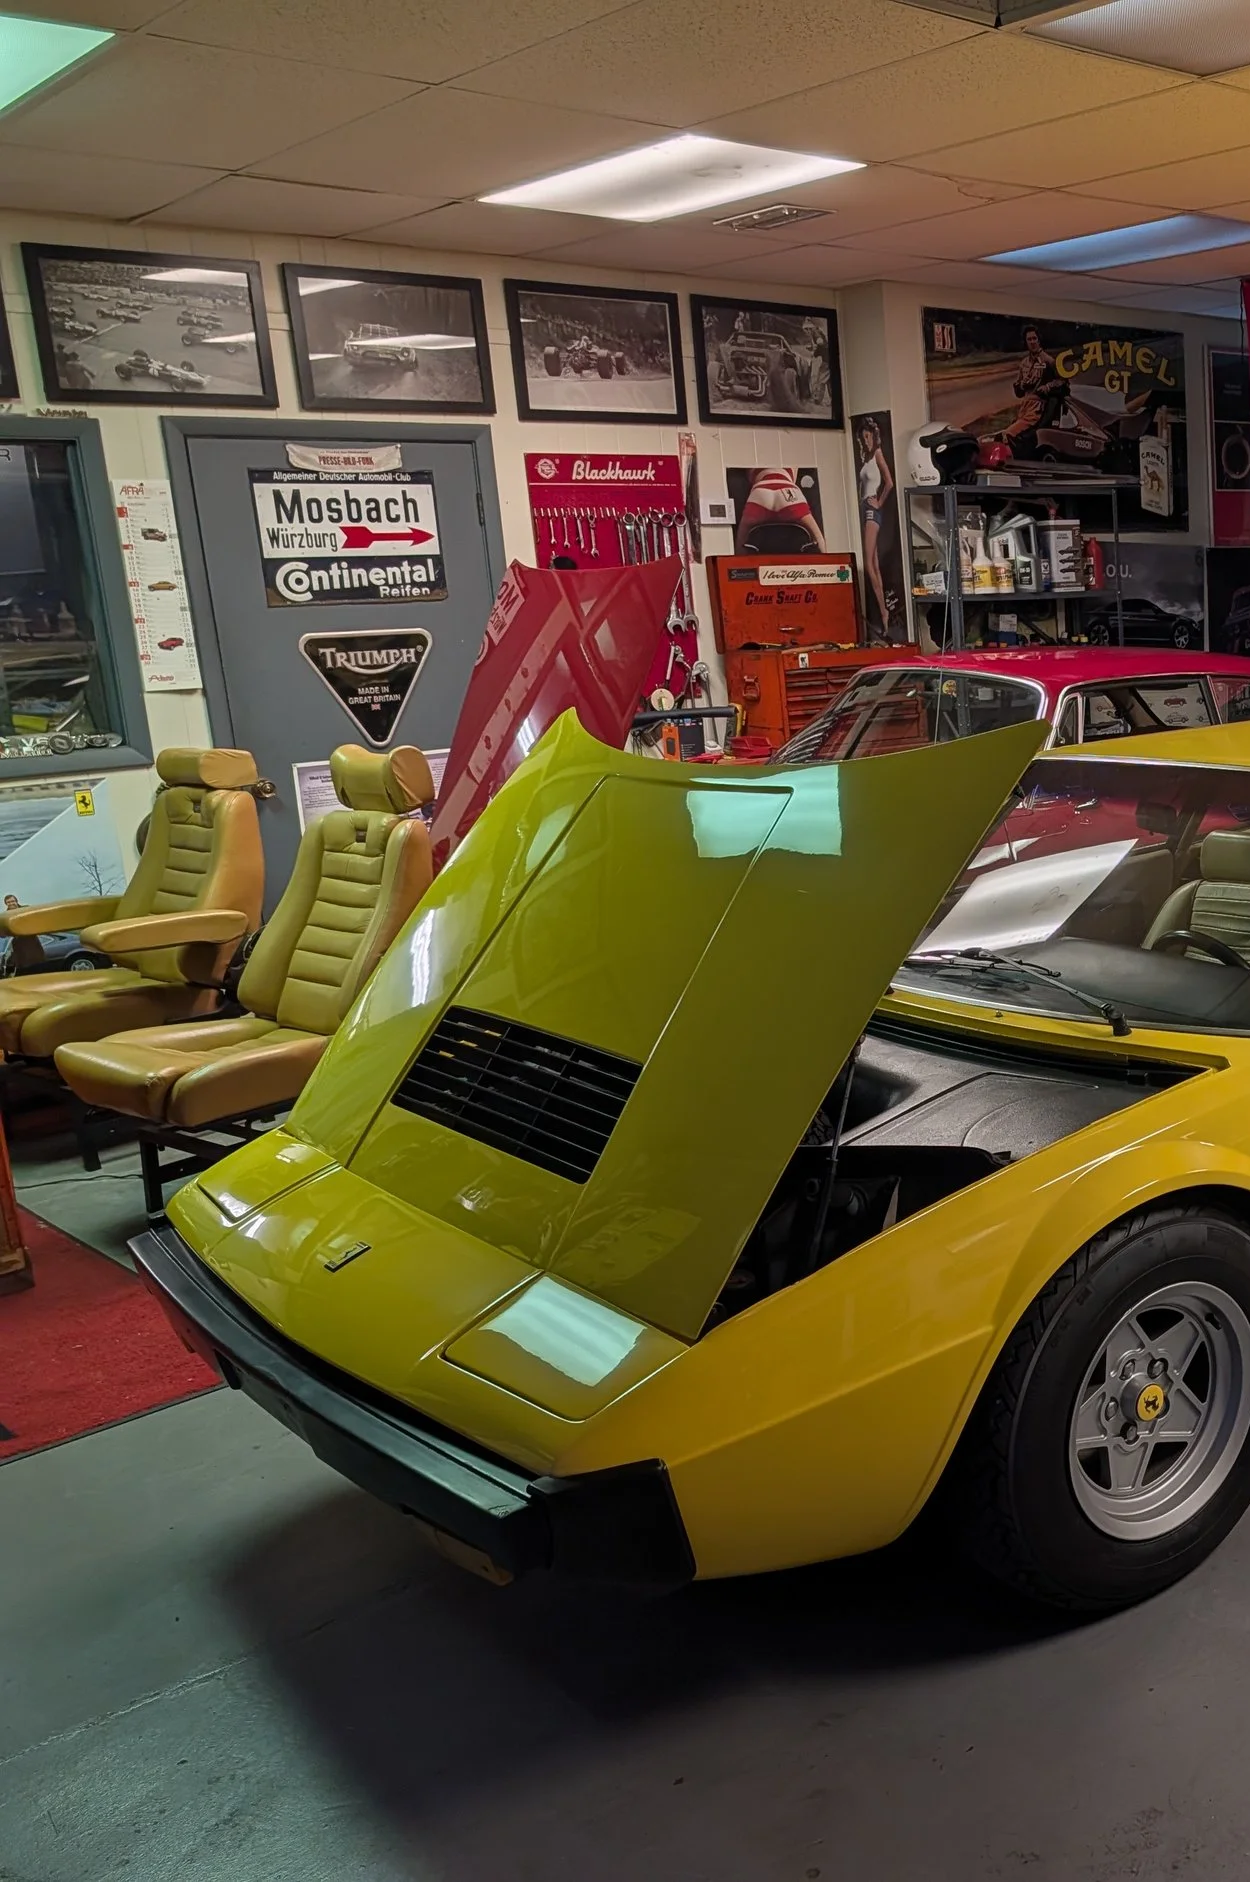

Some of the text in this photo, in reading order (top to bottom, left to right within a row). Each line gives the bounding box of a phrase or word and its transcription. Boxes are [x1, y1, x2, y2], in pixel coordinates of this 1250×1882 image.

[1055, 340, 1176, 386] CAMEL
[1104, 369, 1131, 394] GT
[1141, 452, 1165, 465] CAMEL
[273, 471, 411, 482] Allgemeiner Deutscher Automobil-Club
[572, 460, 656, 481] Blackhawk
[120, 486, 144, 496] AFRA
[272, 489, 420, 524] Mosbach
[266, 527, 338, 552] Würzburg
[275, 558, 436, 602] Continental
[768, 569, 786, 579] love
[786, 569, 807, 582] Alfa
[807, 568, 836, 578] Romeo
[380, 584, 430, 598] Reifen
[745, 592, 774, 605] CRANK
[776, 590, 802, 605] SHAFT
[318, 648, 418, 674] TRIUMPH
[358, 685, 390, 695] MADE IN
[348, 694, 401, 705] GREAT BRITAIN
